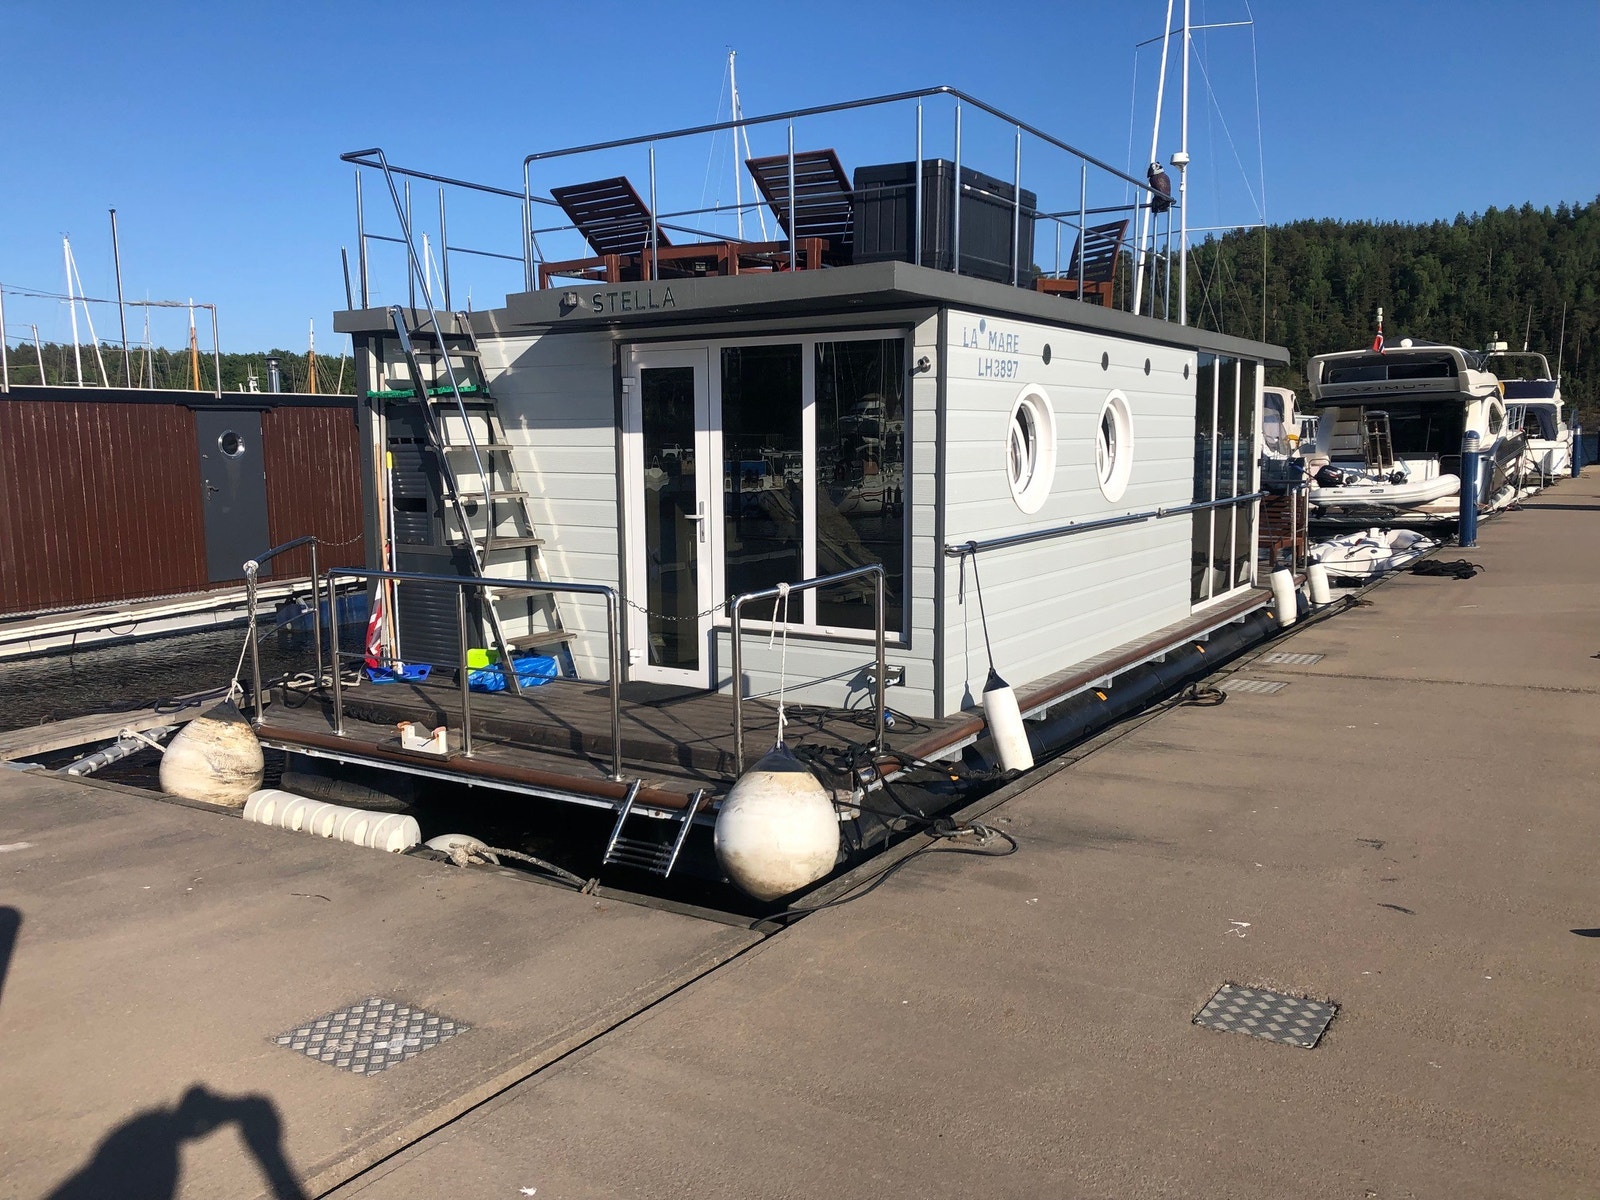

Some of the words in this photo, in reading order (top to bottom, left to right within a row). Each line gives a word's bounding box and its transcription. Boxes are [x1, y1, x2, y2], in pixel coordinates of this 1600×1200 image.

[592, 286, 676, 313] STELLA
[963, 327, 978, 349] LA
[988, 330, 1019, 353] MARE
[978, 357, 1019, 379] LH3897
[1346, 383, 1431, 392] AZIMUT
